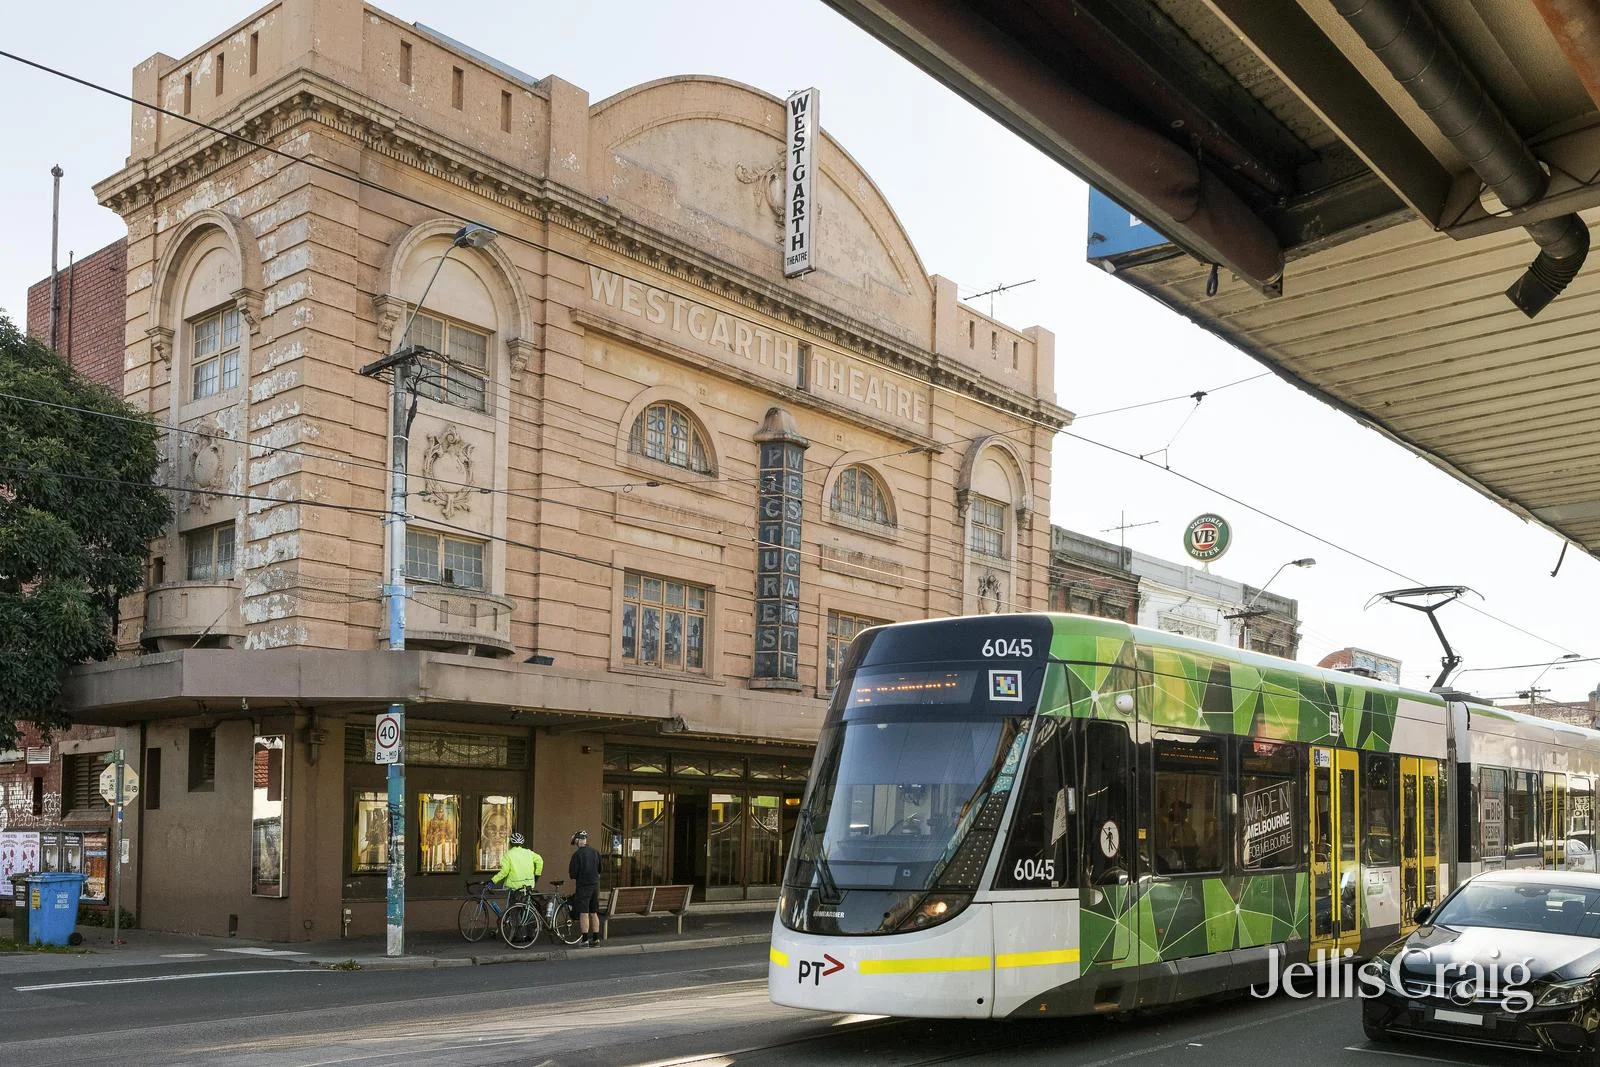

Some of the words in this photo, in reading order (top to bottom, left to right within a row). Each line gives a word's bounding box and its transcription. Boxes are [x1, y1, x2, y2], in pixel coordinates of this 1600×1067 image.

[791, 93, 809, 251] WESTGARTH
[787, 251, 807, 266] THEATRE
[588, 265, 794, 375] WESTGARTH
[811, 350, 929, 425] THEATRE
[1190, 518, 1223, 529] VICTORIA
[761, 448, 781, 649] PICTURES
[1194, 530, 1215, 543] VB
[782, 448, 801, 677] WESTGARTH
[1191, 547, 1219, 556] BITTER
[981, 638, 1034, 658] 6045
[380, 726, 395, 739] 40
[1244, 788, 1278, 824] MADE
[1247, 812, 1290, 840] MELBOURNE
[1260, 831, 1291, 856] MELBOURNE
[1013, 858, 1055, 881] 6045
